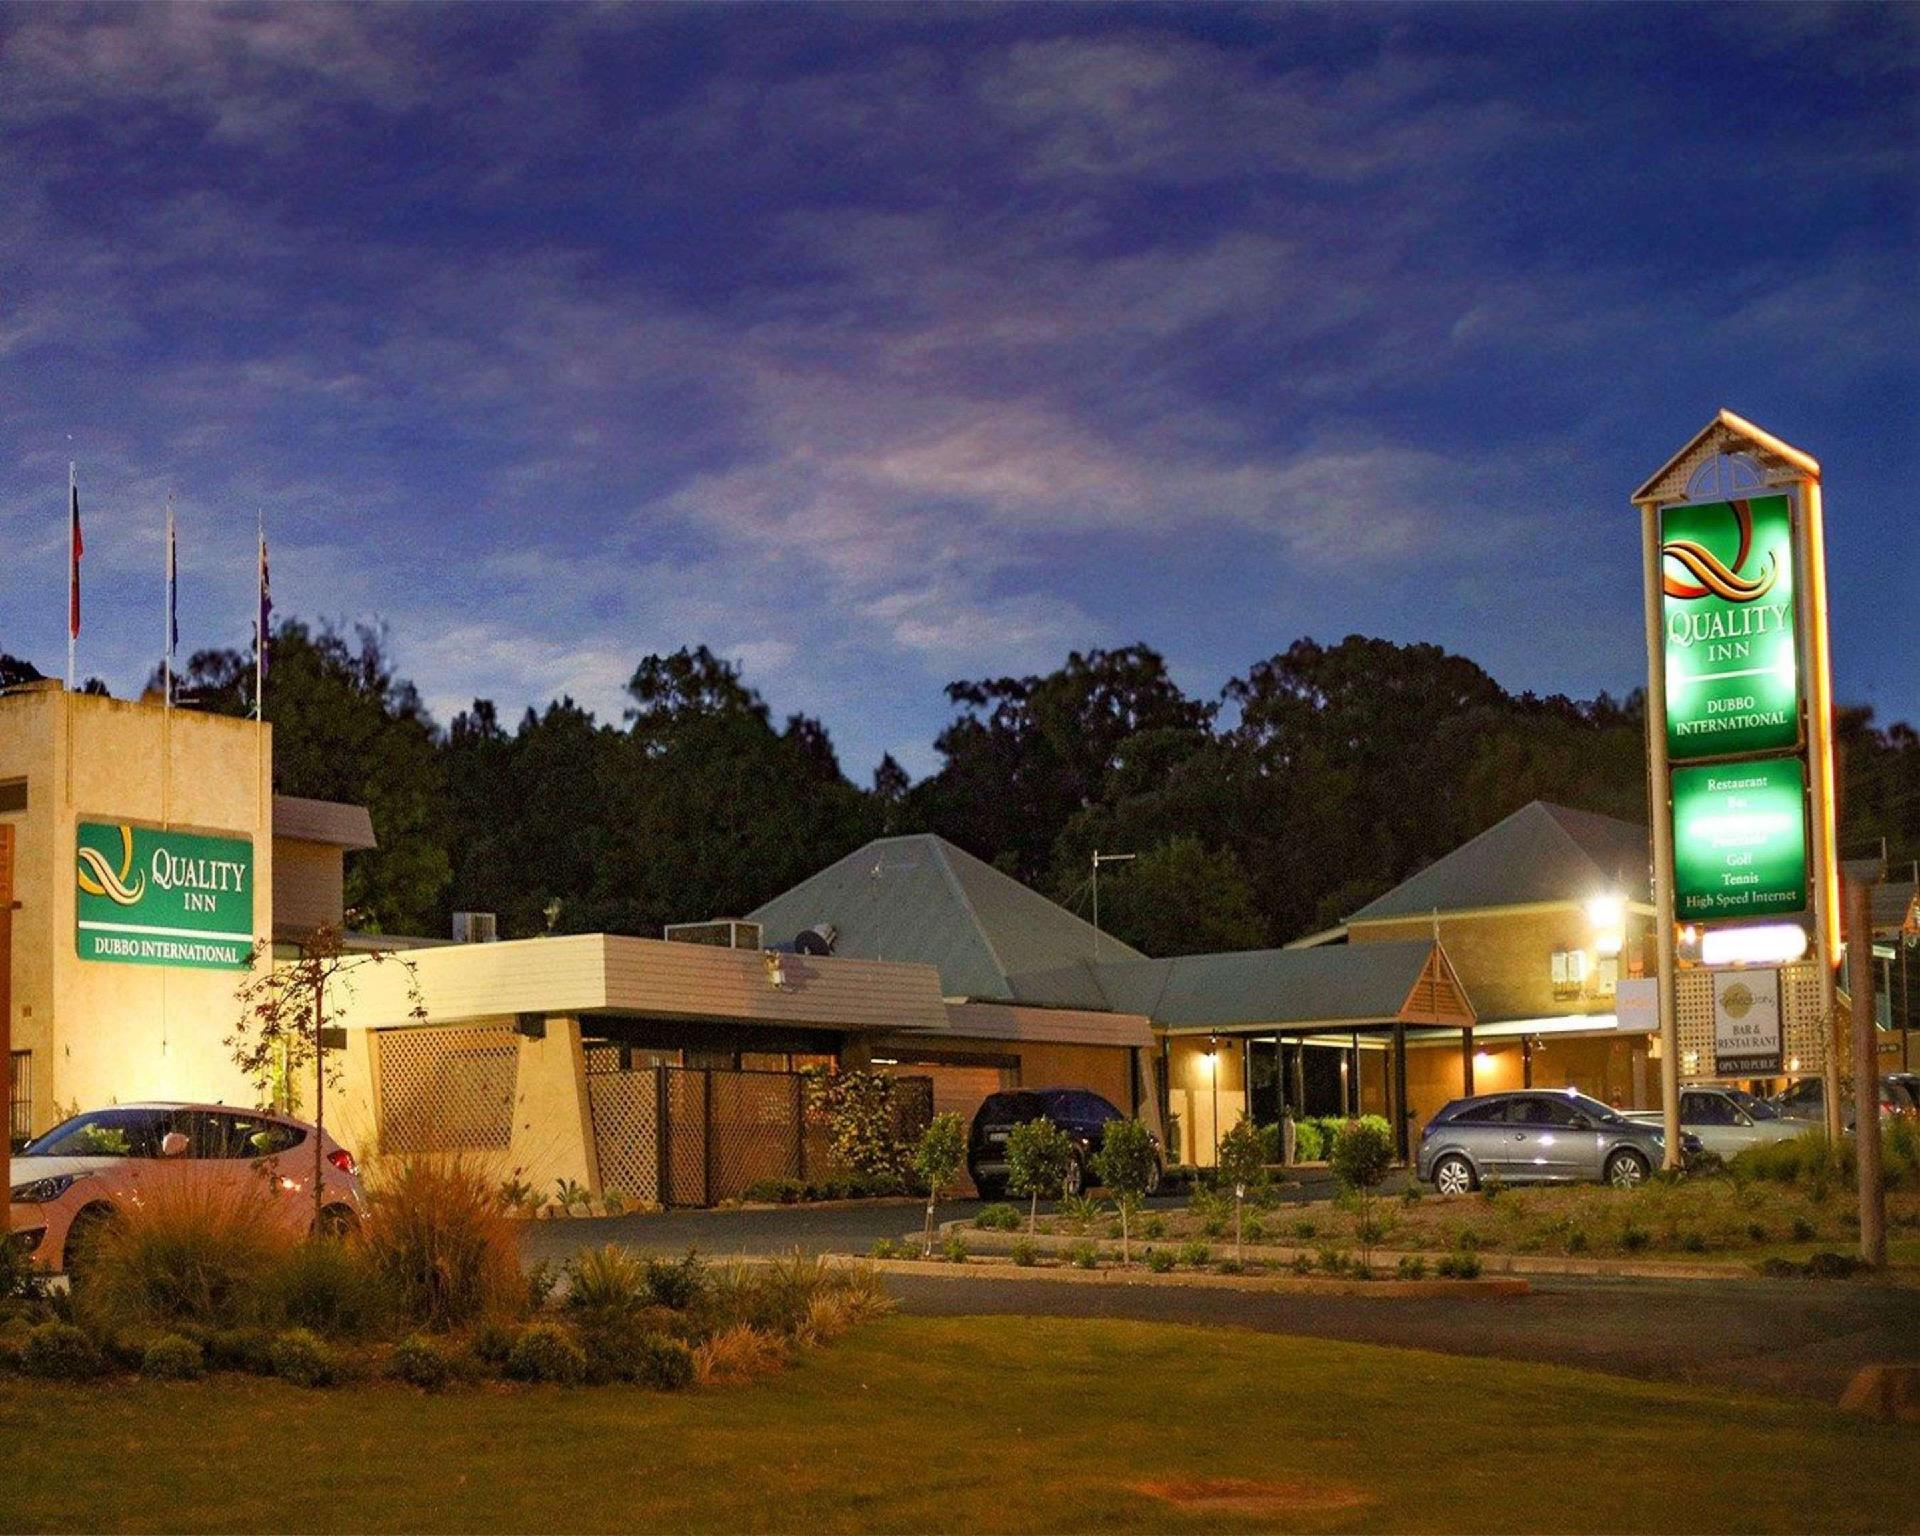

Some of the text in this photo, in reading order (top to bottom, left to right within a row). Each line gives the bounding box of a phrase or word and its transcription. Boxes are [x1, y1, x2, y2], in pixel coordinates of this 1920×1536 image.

[1668, 604, 1790, 647] QUALITY
[1708, 641, 1750, 662] INN
[1707, 696, 1755, 714] DUBBO
[1676, 711, 1787, 736] INTERNATIONAL
[1707, 776, 1768, 791] Restaurant
[152, 848, 246, 892] QUALITY
[1722, 872, 1760, 885] Tennis
[184, 892, 216, 912] INN
[1686, 890, 1797, 909] High Speed Internet
[94, 936, 239, 964] DUBBO INTERNATIONAL
[1733, 1024, 1760, 1035] BAR &
[1718, 1036, 1776, 1049] RESTAURANT
